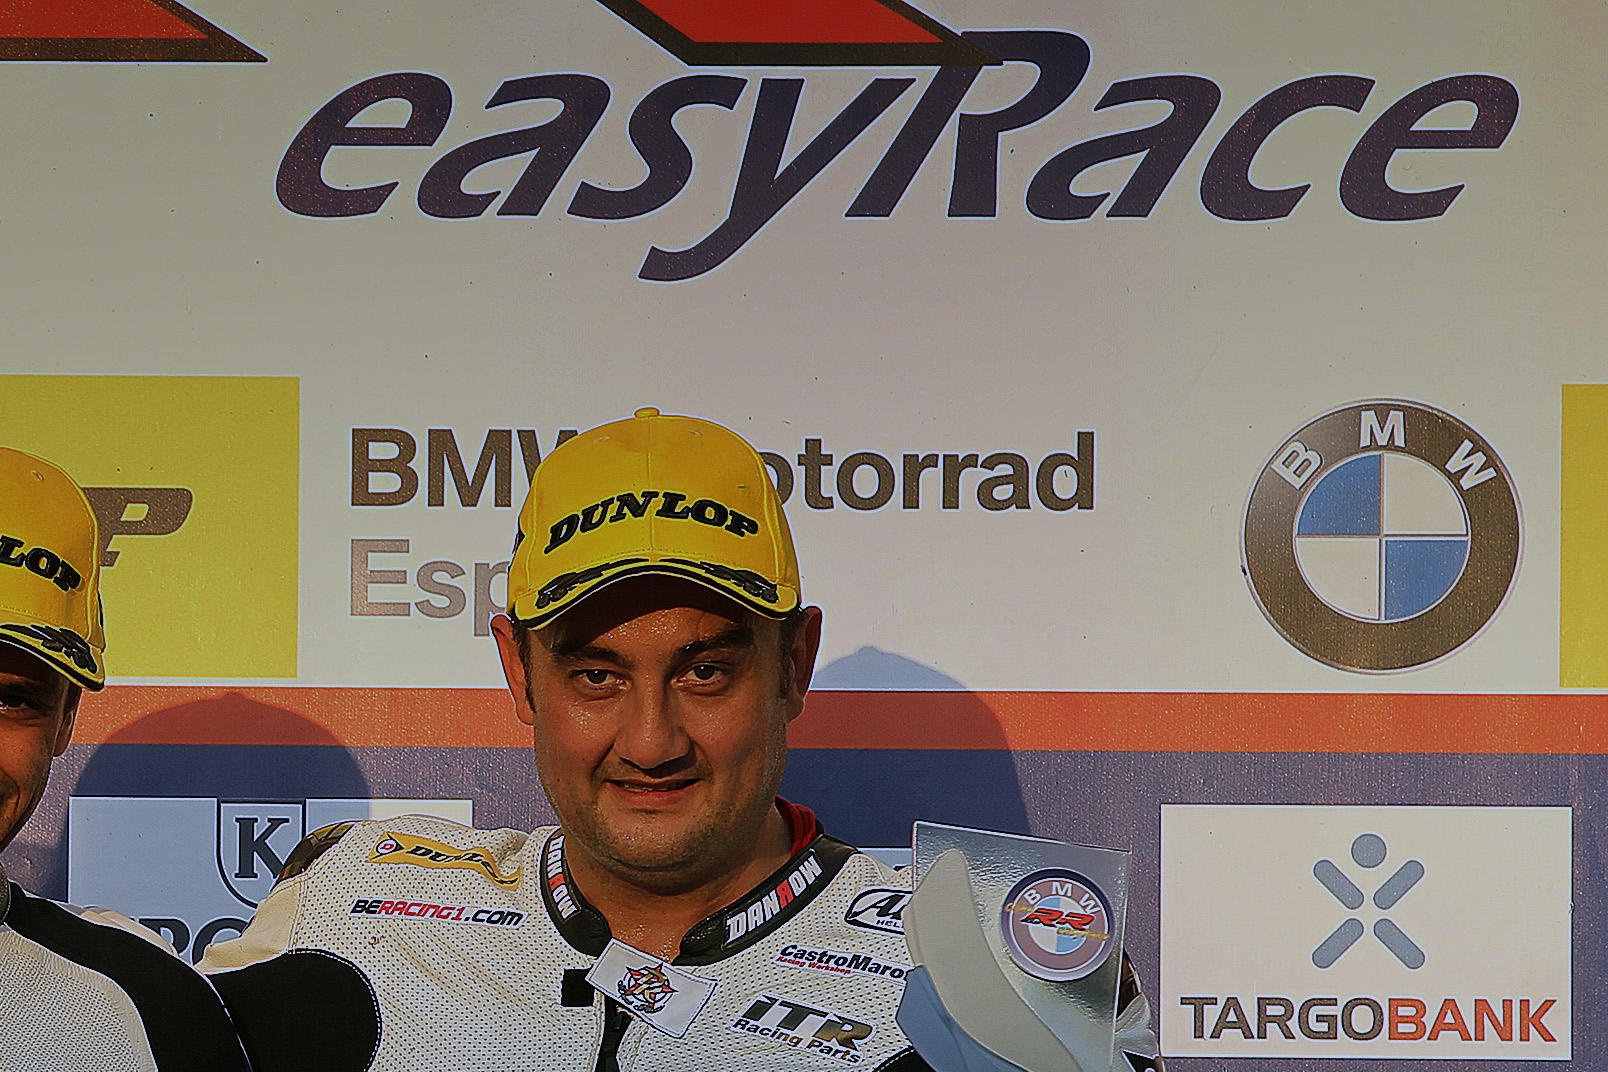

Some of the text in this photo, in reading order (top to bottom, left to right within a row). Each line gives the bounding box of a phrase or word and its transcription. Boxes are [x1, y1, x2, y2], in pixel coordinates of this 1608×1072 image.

[276, 28, 1522, 281] easyRace
[759, 431, 1094, 512] torrad
[1270, 410, 1498, 492] BMW
[544, 490, 760, 555] DUNLOP
[1023, 881, 1101, 914] BMW
[777, 957, 851, 975] Racing Workshop
[780, 945, 908, 981] CastroMaro
[732, 1018, 863, 1064] Racing Parts
[1180, 997, 1557, 1042] TARGOBANK
